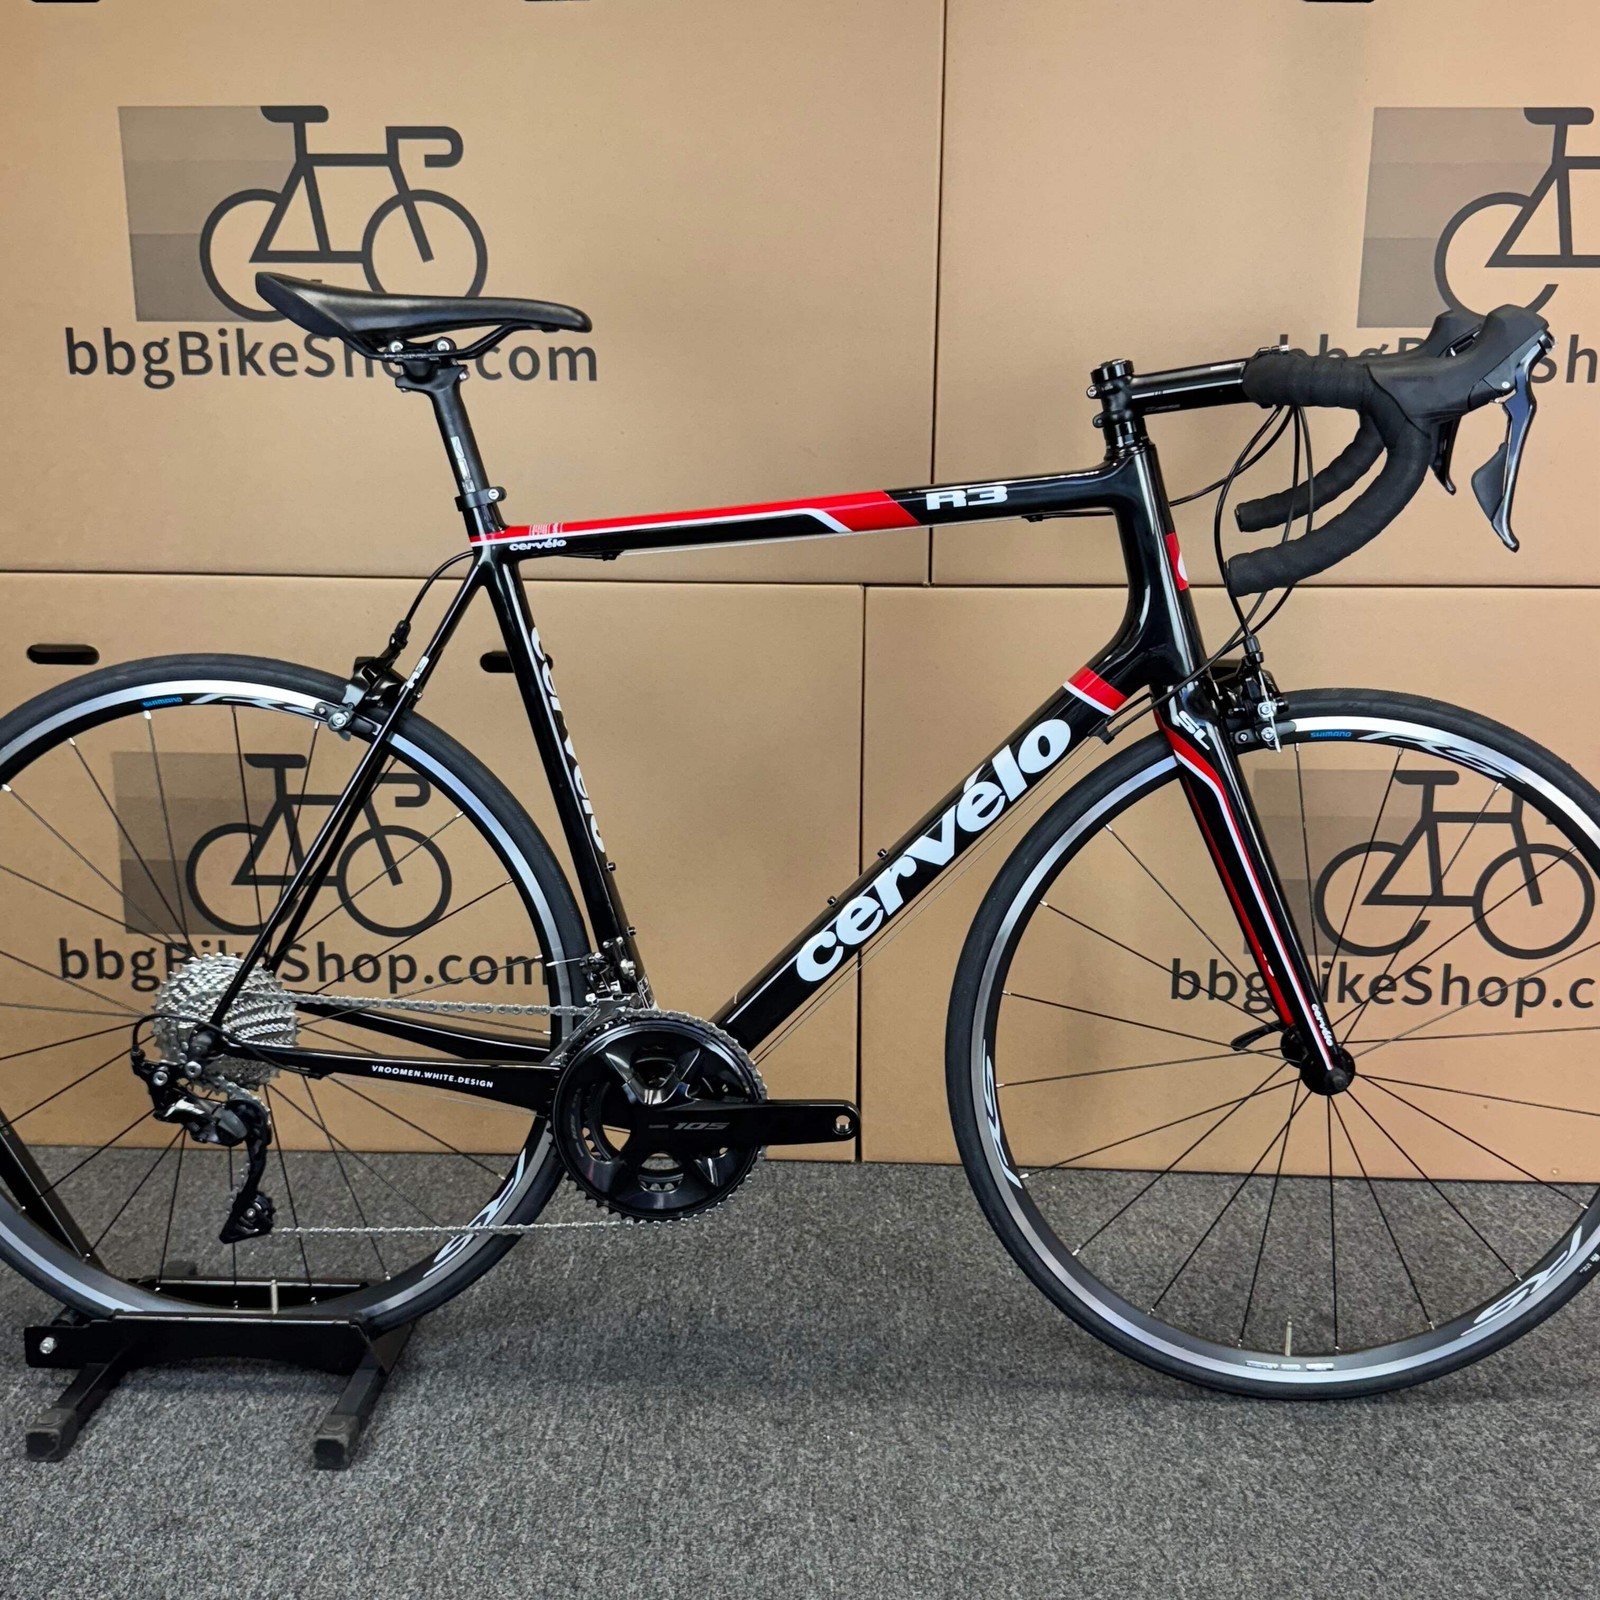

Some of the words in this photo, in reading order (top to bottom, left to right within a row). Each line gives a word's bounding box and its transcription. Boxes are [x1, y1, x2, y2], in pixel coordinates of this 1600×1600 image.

[65, 327, 598, 390] bbgBikeShcom
[926, 486, 1008, 510] R3
[509, 539, 567, 551] cervélo
[1179, 710, 1211, 750] SL
[796, 719, 1072, 982] cervélo
[1171, 957, 1596, 1019] bbgikeShop.c
[372, 1065, 494, 1088] VROOMEN.WHITE.DESIGN
[673, 1122, 730, 1130] 105
